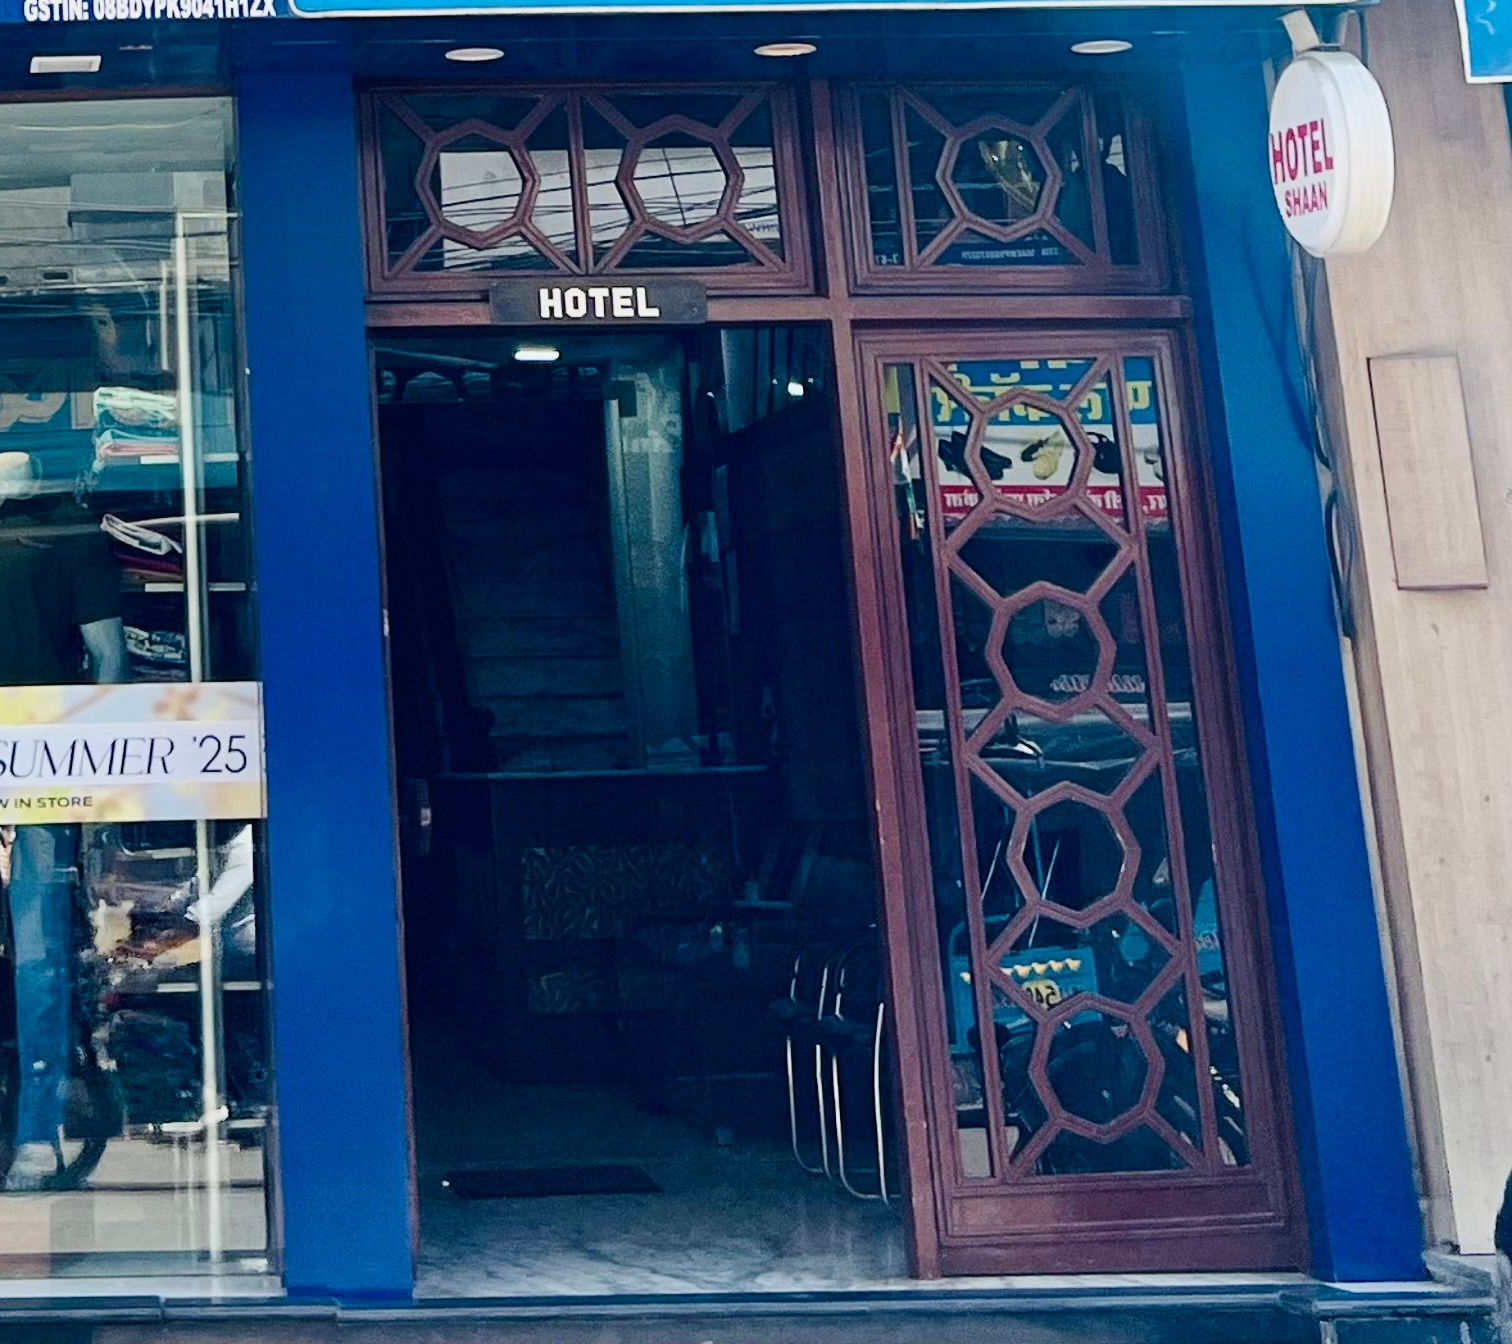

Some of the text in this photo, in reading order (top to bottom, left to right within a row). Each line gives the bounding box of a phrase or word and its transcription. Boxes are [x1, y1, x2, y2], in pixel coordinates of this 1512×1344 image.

[1270, 118, 1334, 184] HOTEL
[1285, 181, 1328, 218] SHAAN
[539, 287, 660, 318] HOTEL
[191, 734, 248, 775] '25
[13, 797, 32, 810] IN
[36, 795, 93, 809] STORE
